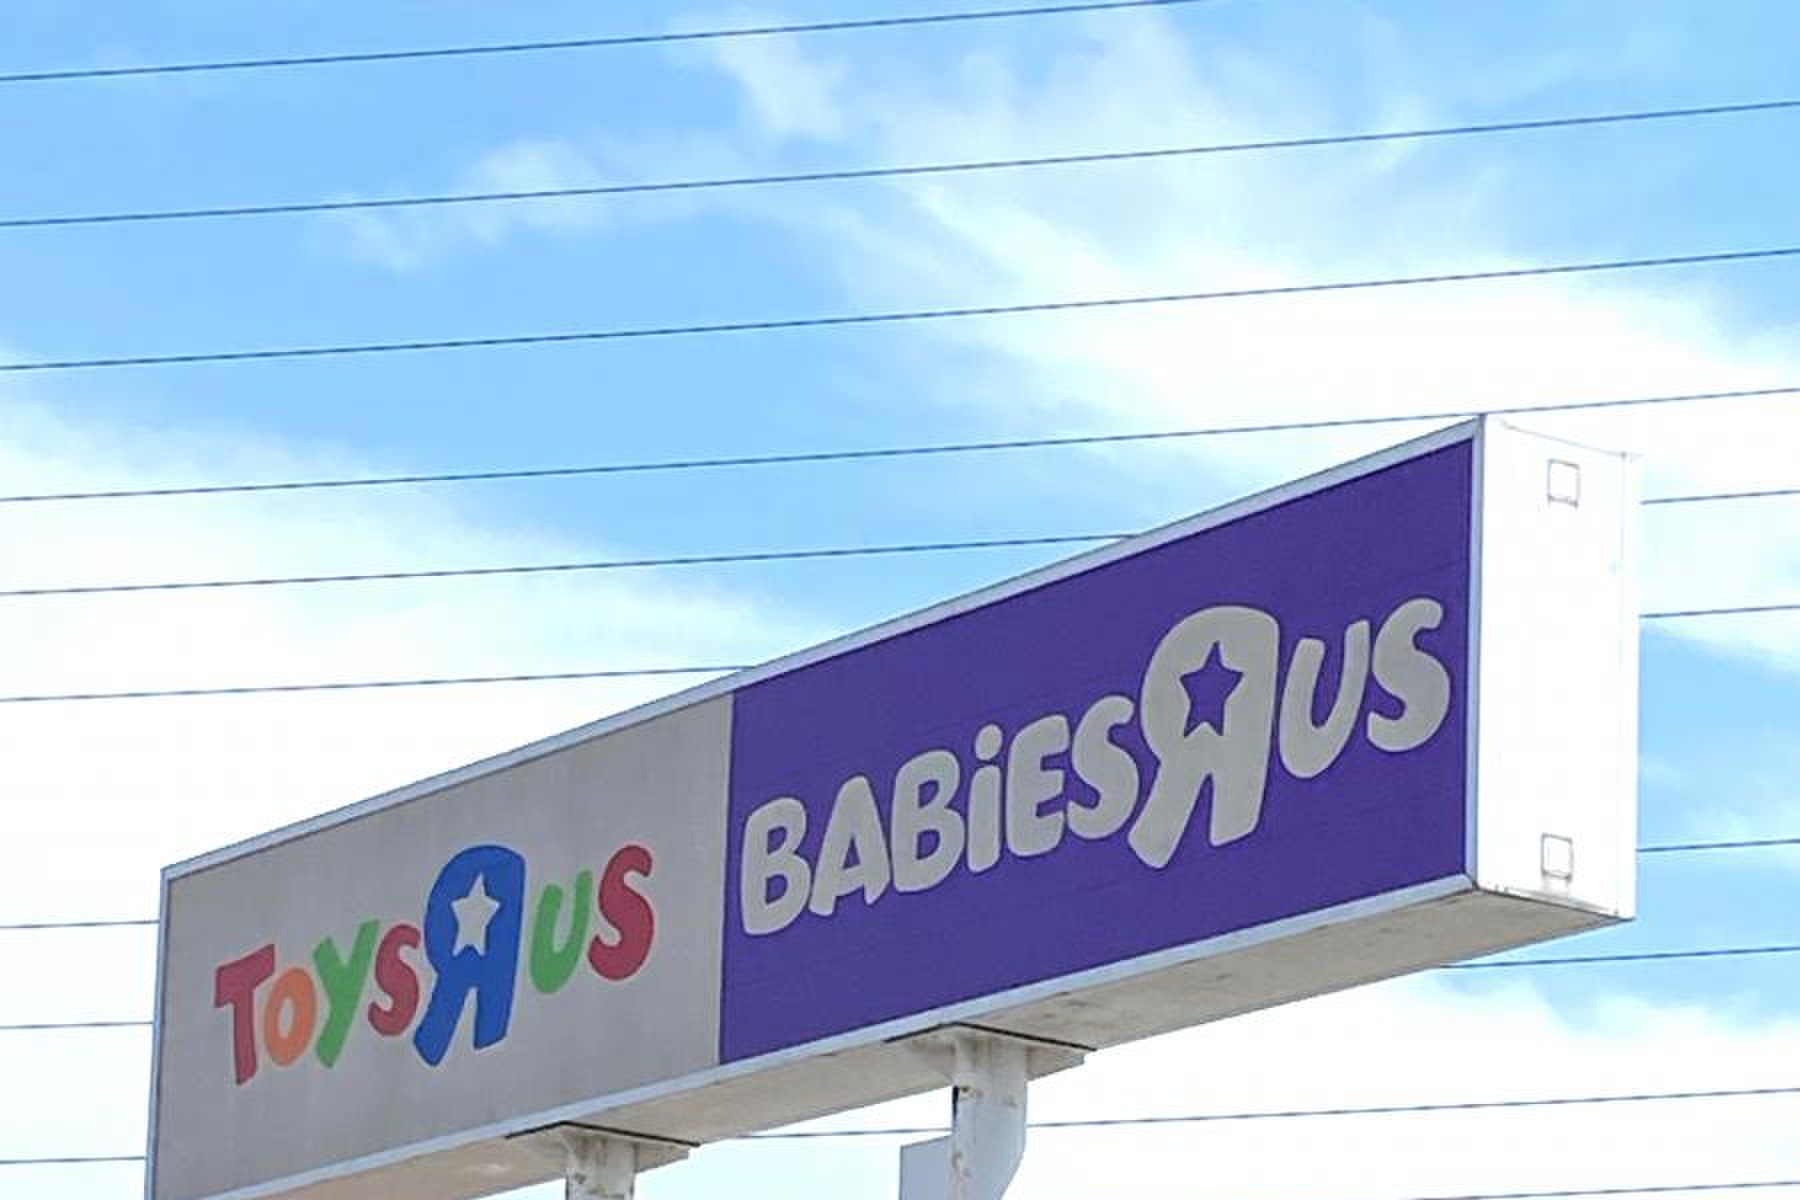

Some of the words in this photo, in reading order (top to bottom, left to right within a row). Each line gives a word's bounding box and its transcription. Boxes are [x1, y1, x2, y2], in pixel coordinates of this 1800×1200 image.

[1278, 598, 1451, 778] US
[214, 918, 421, 1085] TOYS
[529, 844, 655, 994] US
